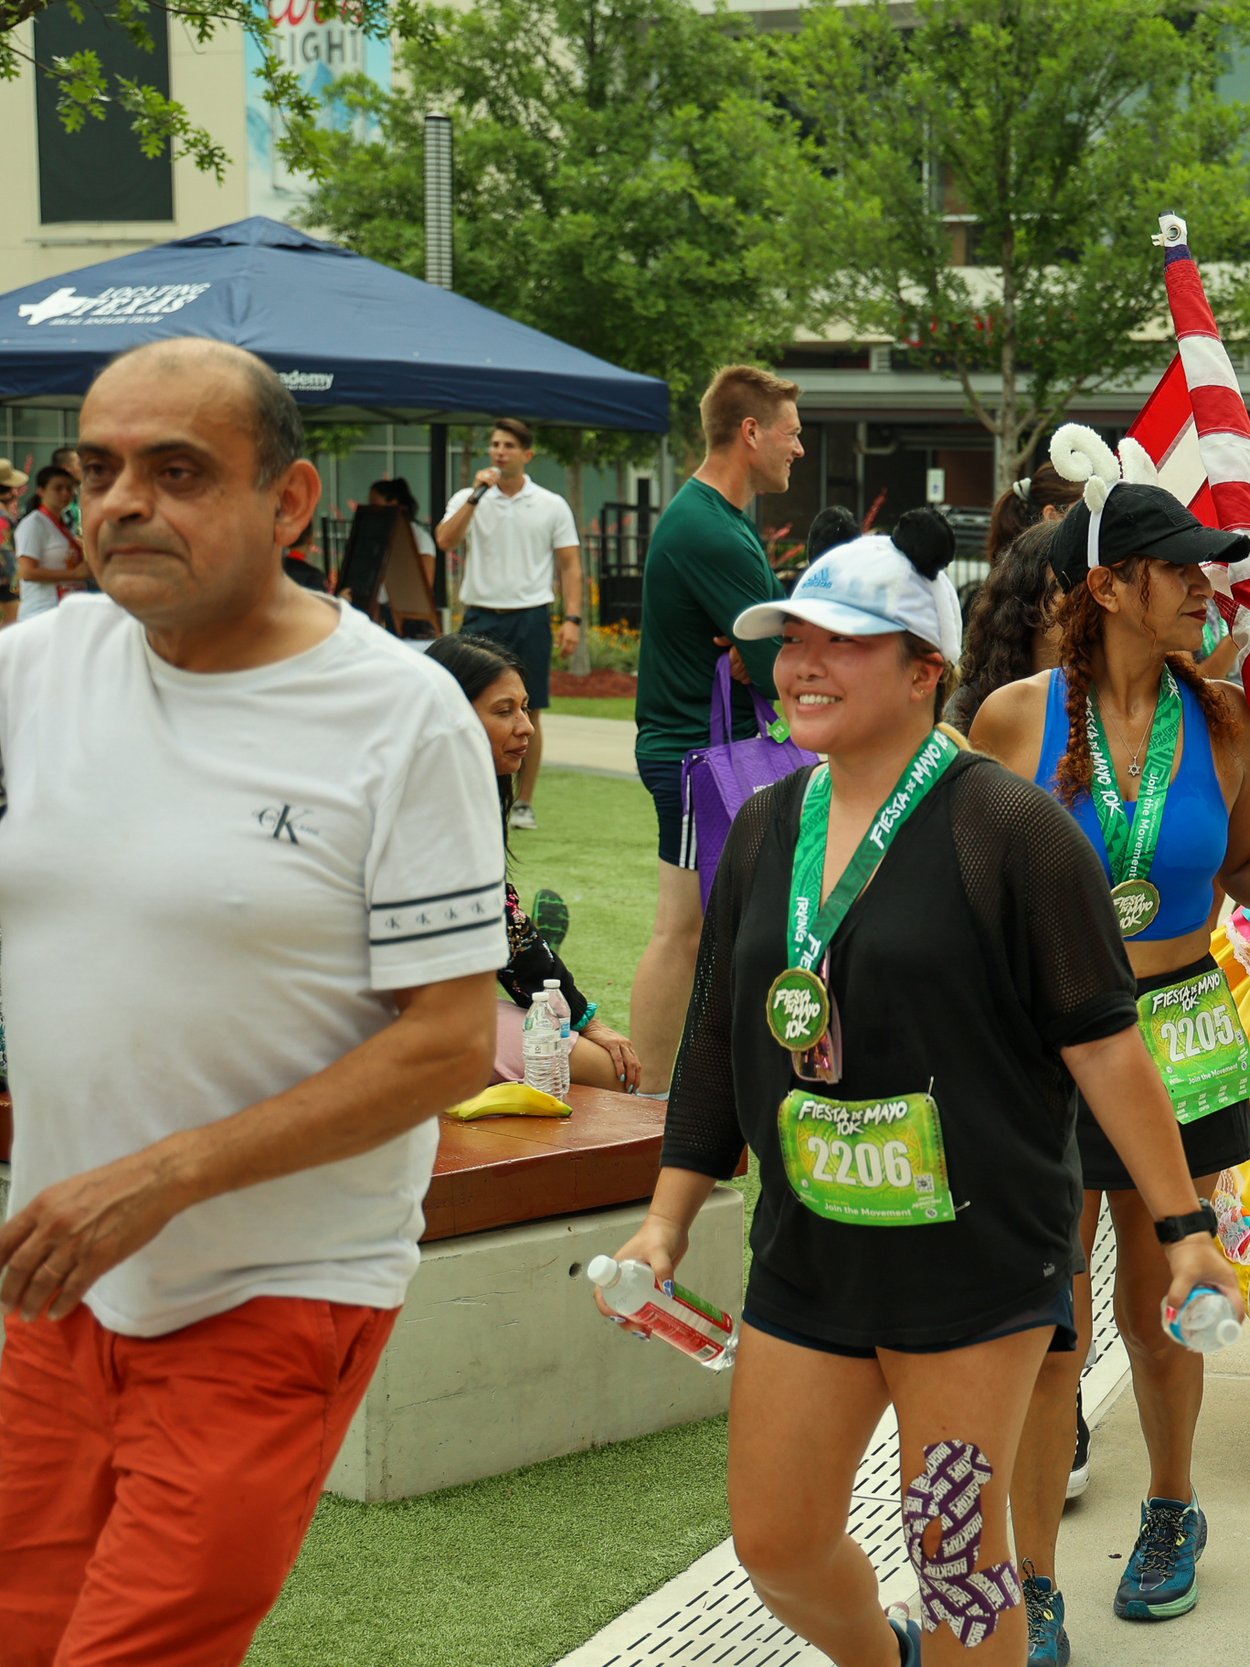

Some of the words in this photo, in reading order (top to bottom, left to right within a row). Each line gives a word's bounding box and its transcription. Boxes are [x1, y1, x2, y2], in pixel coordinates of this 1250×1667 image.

[100, 282, 211, 300] LOCATING
[69, 294, 199, 317] TEXAS
[910, 743, 942, 785] MAYO
[1090, 751, 1113, 786] MAYO
[905, 778, 917, 794] DE
[1144, 772, 1160, 797] Join
[1099, 788, 1125, 817] 10K
[1142, 797, 1154, 816] the
[869, 791, 911, 851] FIESTA
[1128, 817, 1151, 878] Movement
[794, 896, 811, 943] IRVING
[1127, 901, 1154, 916] MAYO
[773, 988, 812, 1010] FIESTA
[1152, 985, 1192, 1015] FIESTA
[1190, 984, 1198, 995] DE
[1197, 972, 1221, 995] MAYO
[1182, 993, 1200, 1014] 10K
[792, 1001, 821, 1020] MAYO
[785, 1019, 812, 1040] 10K
[1160, 1004, 1236, 1064] 2205
[1188, 1075, 1201, 1086] Join
[1200, 1072, 1212, 1082] the
[1211, 1062, 1239, 1078] Movement
[798, 1100, 849, 1122] FIESTA
[851, 1110, 862, 1121] DE
[863, 1101, 909, 1126] MAYO
[835, 1120, 865, 1136] 10K
[807, 1135, 913, 1189] 2206
[824, 1202, 843, 1212] Join
[843, 1205, 859, 1216] the
[860, 1207, 913, 1217] Movement
